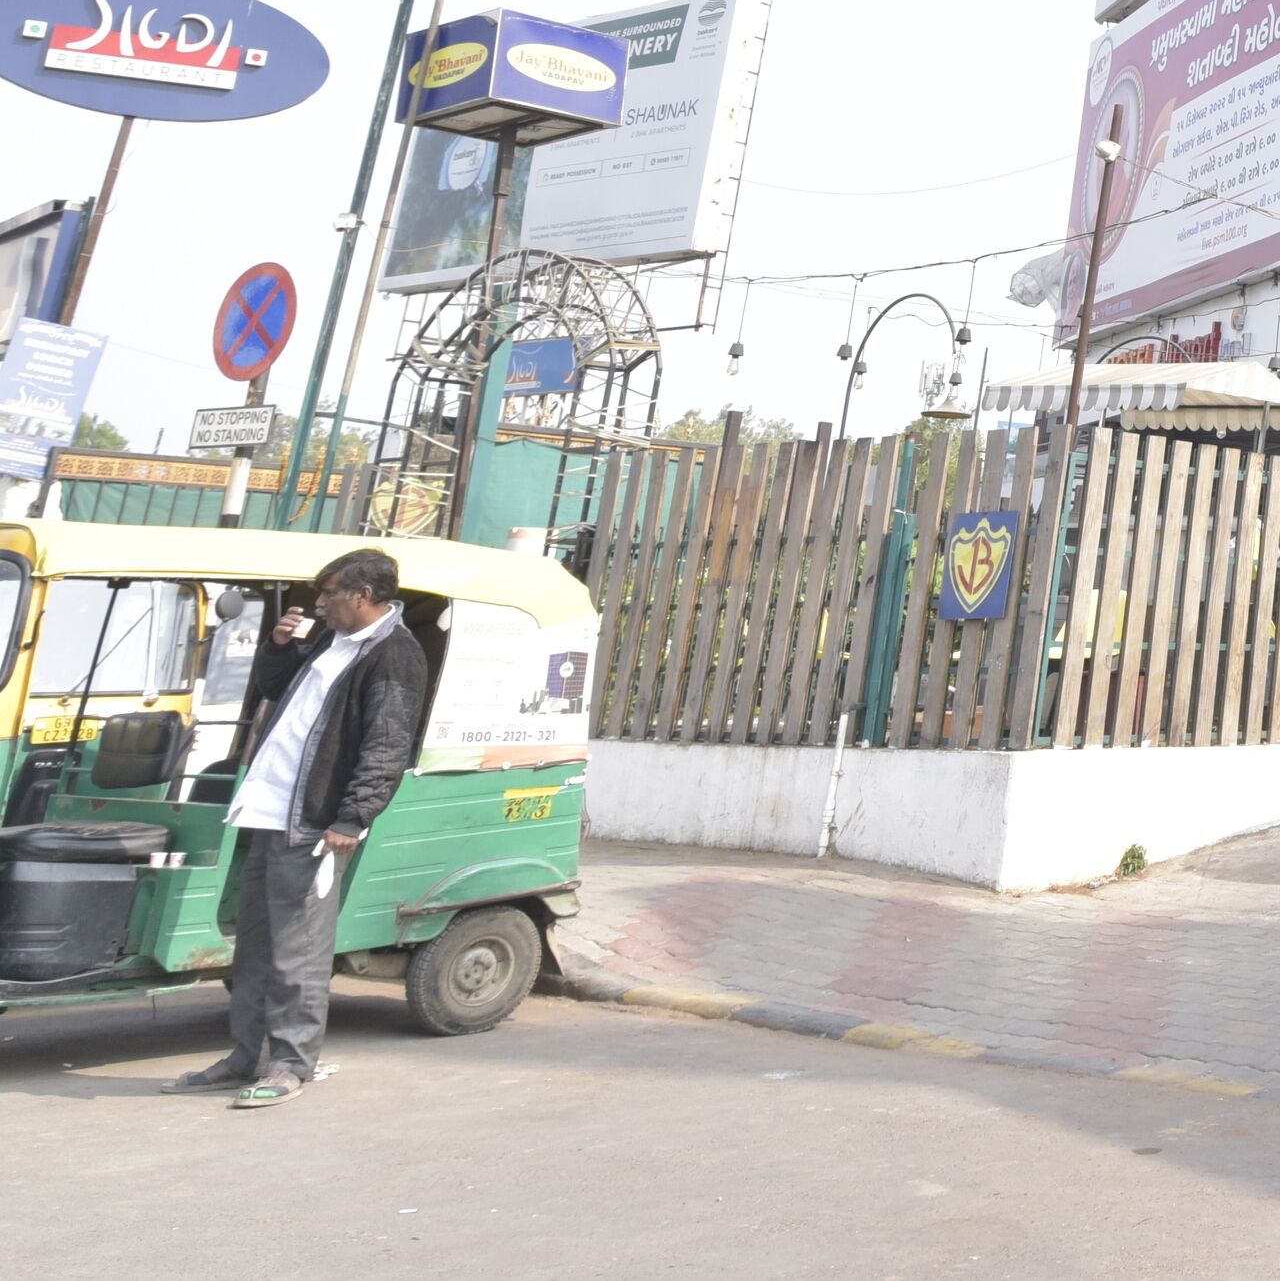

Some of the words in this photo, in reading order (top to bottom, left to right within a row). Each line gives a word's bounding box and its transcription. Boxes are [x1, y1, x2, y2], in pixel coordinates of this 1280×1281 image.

[621, 17, 682, 38] SURROUNDED
[629, 32, 678, 57] NERY
[1187, 22, 1239, 87] શતાબ્દી
[57, 53, 222, 85] RESTAURANT
[438, 52, 482, 71] Bhavani
[516, 50, 543, 68] Jay
[546, 56, 608, 83] Bhavani
[542, 70, 585, 86] VADAPAV
[625, 99, 699, 126] SHAUNAK
[199, 412, 215, 426] NO
[217, 410, 268, 426] STOPPING
[196, 429, 211, 443] NO
[213, 427, 264, 442] STANDING
[461, 731, 492, 743] 1800
[537, 729, 556, 741] 321
